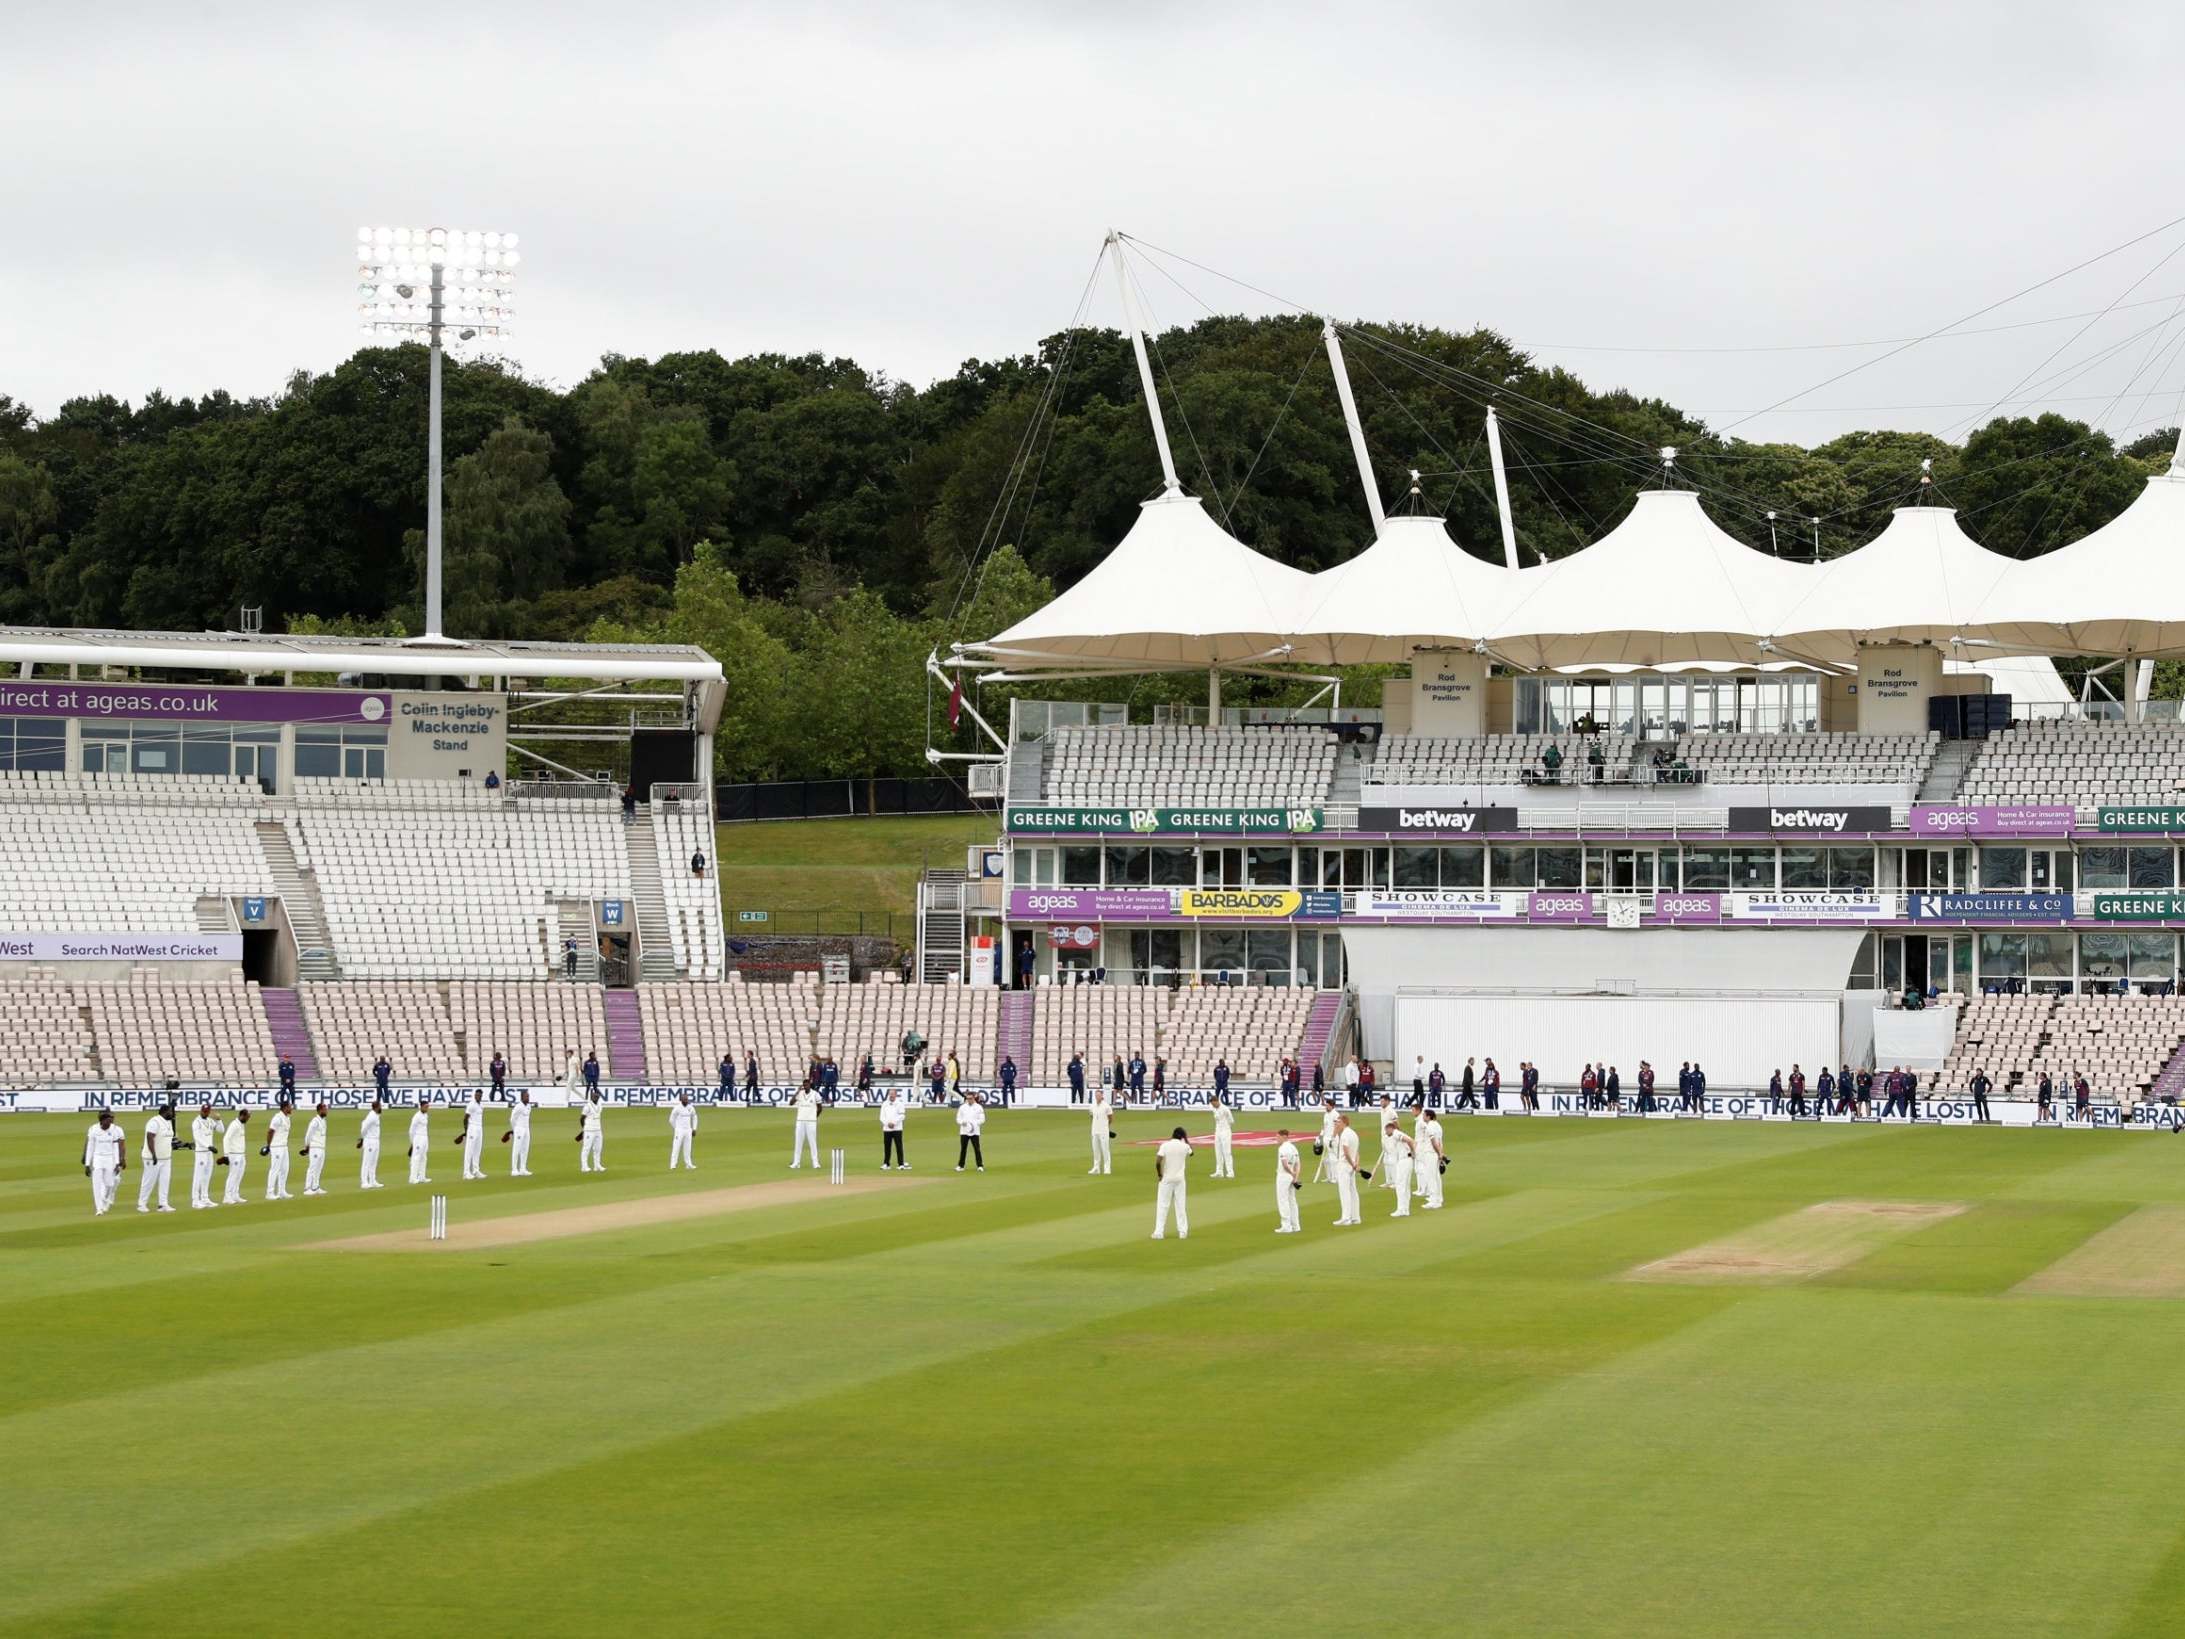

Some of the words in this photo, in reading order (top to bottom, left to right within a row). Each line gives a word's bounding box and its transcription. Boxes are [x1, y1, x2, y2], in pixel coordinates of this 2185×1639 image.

[1438, 673, 1455, 681] Rod
[1884, 669, 1902, 677] Rod
[1422, 683, 1471, 692] Bransgrove
[1867, 679, 1918, 688] Bransgrove
[56, 691, 79, 709] at
[86, 693, 219, 714] ageas.co.uk
[401, 702, 439, 716] Colin
[412, 720, 489, 734] Mackenzie
[433, 739, 469, 751] Stand
[1013, 813, 1076, 826] GREENE
[1082, 813, 1123, 826] KING
[1129, 809, 1160, 829] IPA
[1170, 813, 1233, 826] GREENE
[1239, 813, 1280, 827] KING
[1286, 809, 1317, 829] IPA
[1399, 809, 1477, 832] betway
[1770, 809, 1849, 832] betway
[1927, 810, 1980, 831] ageas
[2104, 812, 2170, 825] GREENE
[1028, 895, 1078, 913] ageas
[1191, 893, 1284, 908] BARBADOS
[1371, 892, 1502, 903] SHOWCASE
[1748, 895, 1881, 904] SHOWCASE
[1944, 900, 2023, 910] RADCLIFFE
[2028, 899, 2039, 910] &
[250, 906, 259, 917] V
[1535, 897, 1584, 916] ageas
[1662, 898, 1712, 917] ageas
[2099, 901, 2165, 914] GREENE
[606, 909, 619, 919] W
[61, 944, 109, 956] Search
[111, 944, 167, 956] NatWest
[170, 944, 218, 956] Cricket
[84, 1091, 104, 1108] IN
[307, 1089, 375, 1105] THOSE
[418, 1088, 473, 1104] HAVE
[768, 1087, 796, 1102] OF
[1249, 1091, 1277, 1107] OF
[1281, 1091, 1344, 1108] HOSE
[1444, 1093, 1486, 1110] LOS
[1552, 1095, 1571, 1111] IN
[1728, 1098, 1756, 1114] OF
[1868, 1101, 1922, 1118] HAE
[1926, 1102, 1976, 1119] LOST
